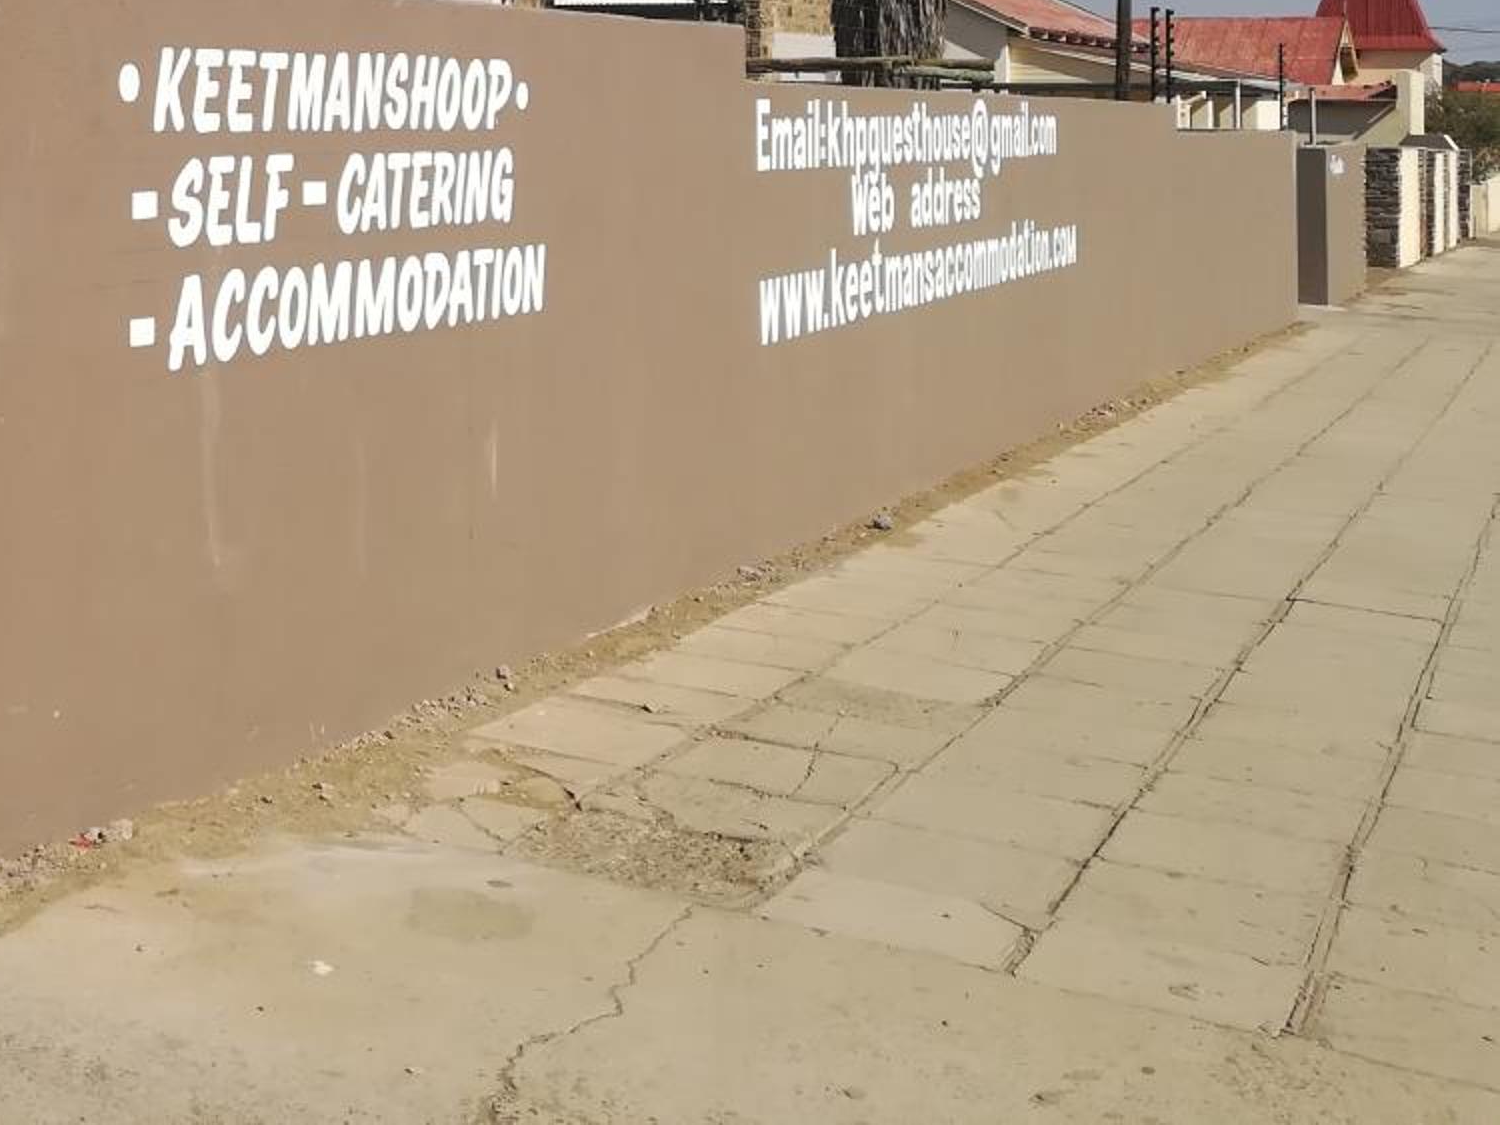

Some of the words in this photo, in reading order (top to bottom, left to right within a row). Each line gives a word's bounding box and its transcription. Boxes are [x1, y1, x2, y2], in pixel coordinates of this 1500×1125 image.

[153, 46, 513, 133] KEETMANSHOOP
[851, 172, 895, 235] Web
[911, 166, 981, 227] address
[167, 243, 546, 371] ACCOMMODATION
